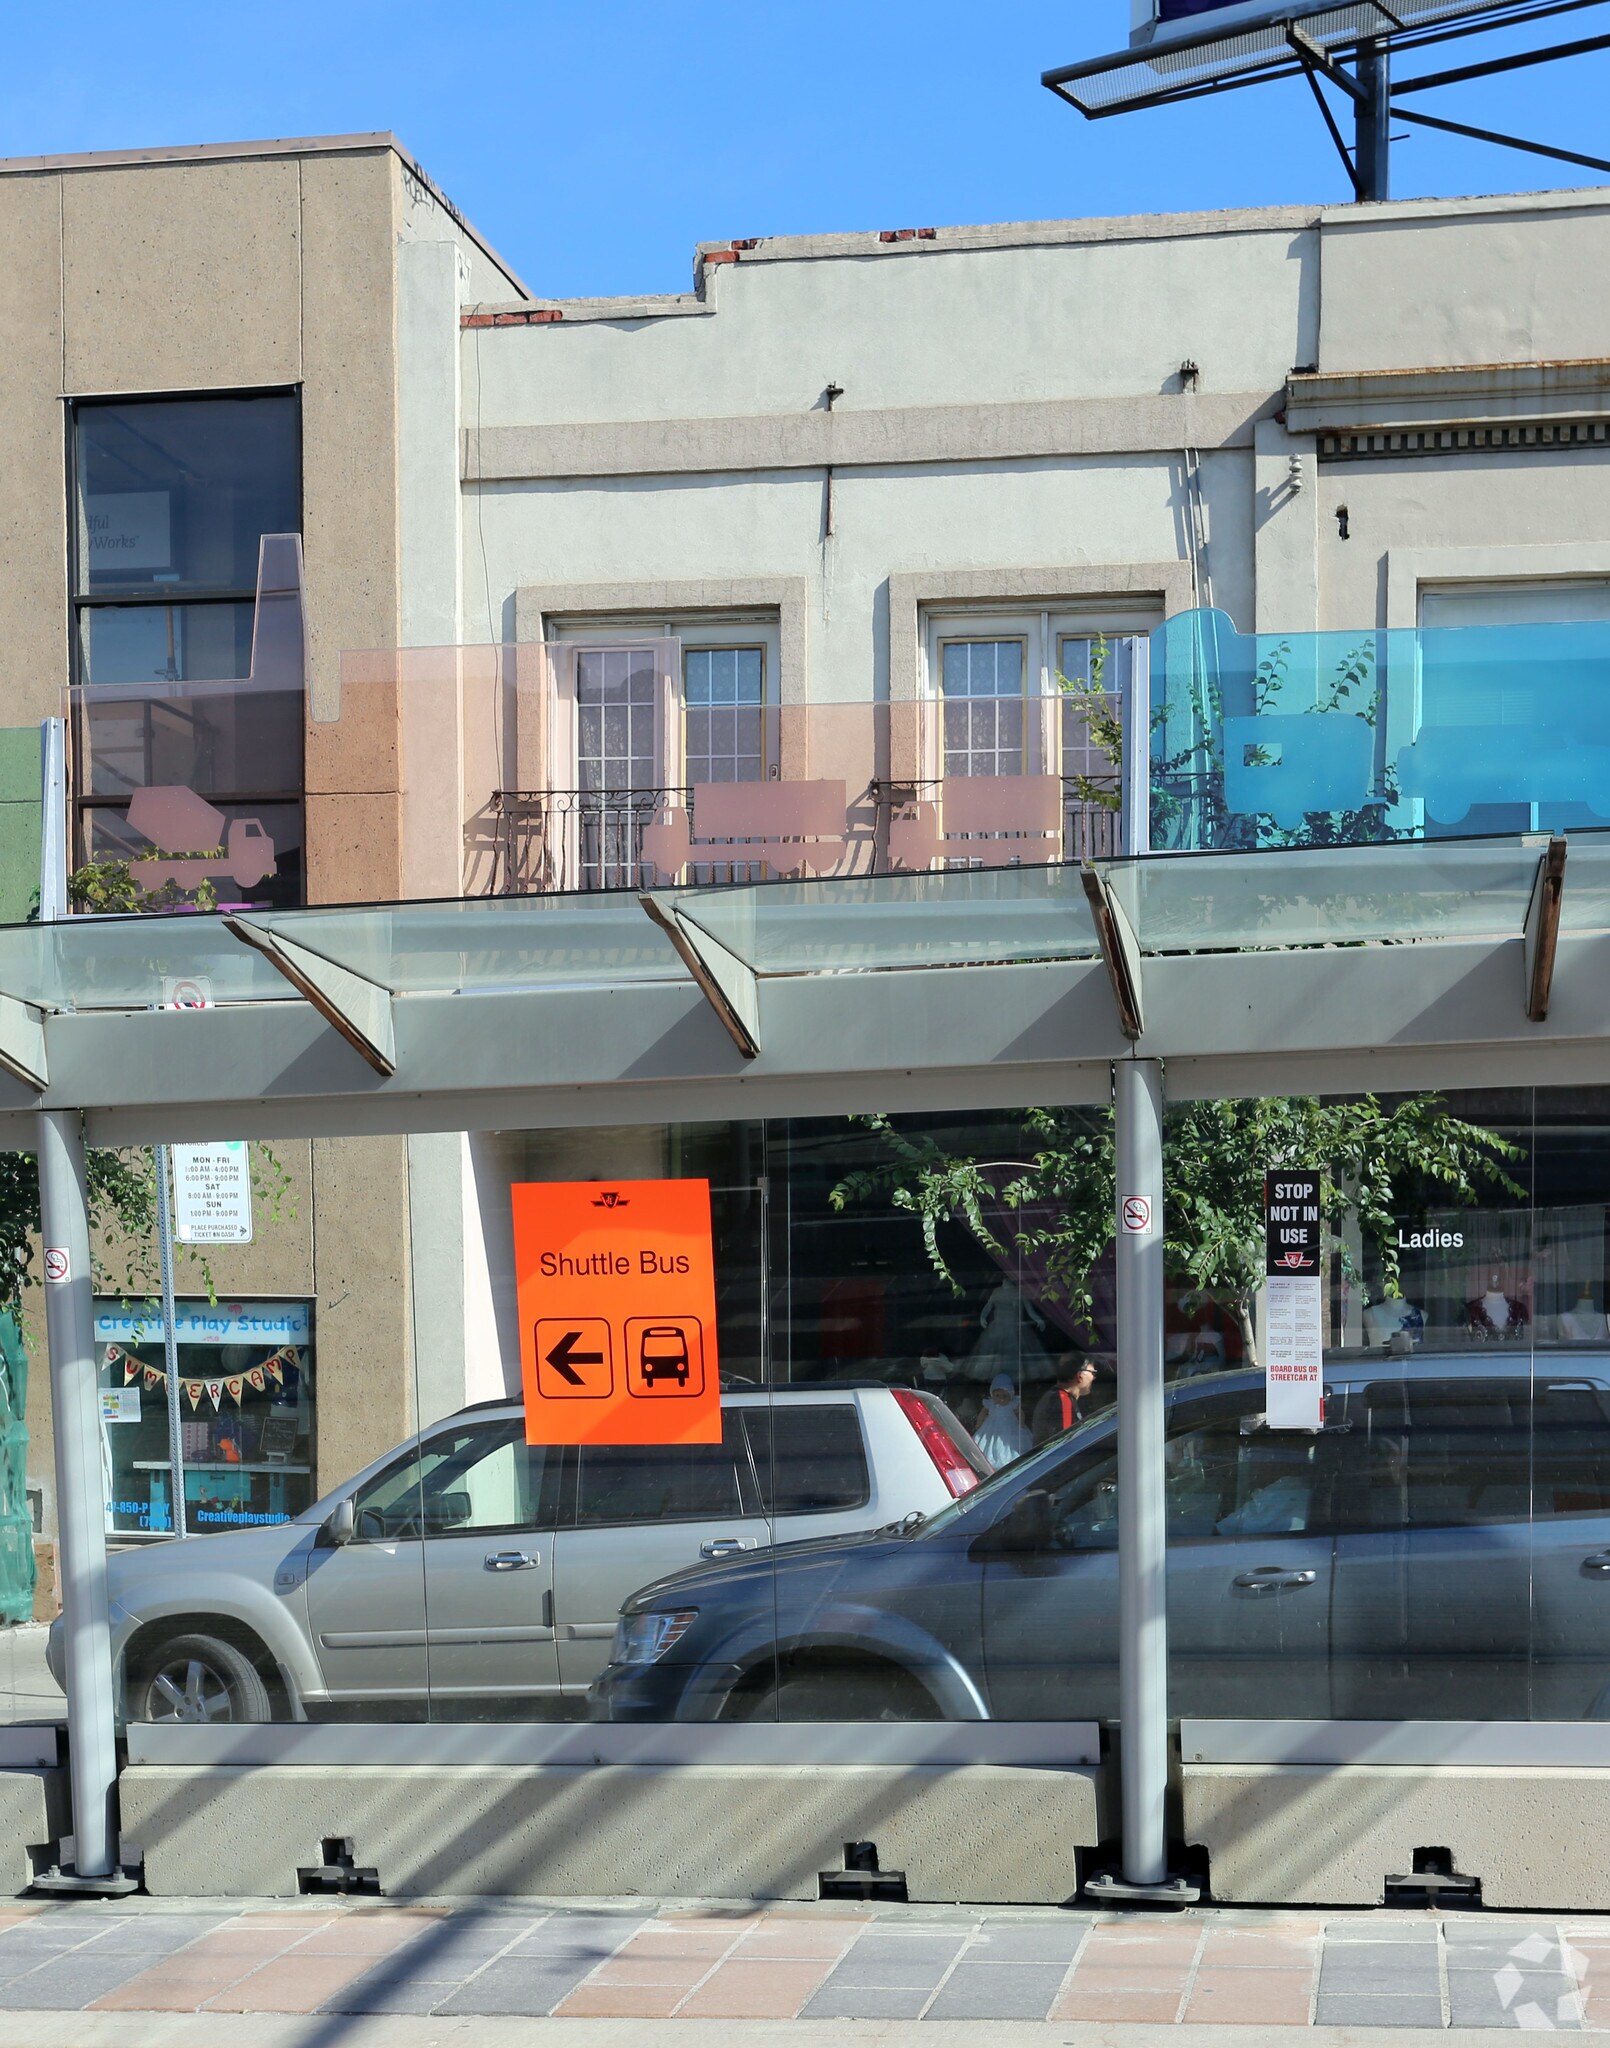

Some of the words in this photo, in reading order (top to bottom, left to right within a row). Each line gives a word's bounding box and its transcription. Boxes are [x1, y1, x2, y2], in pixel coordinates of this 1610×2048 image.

[1275, 1183, 1313, 1199] STOP
[1270, 1206, 1299, 1221] NOT
[1303, 1206, 1318, 1221] IN
[1280, 1228, 1308, 1244] USE
[1398, 1228, 1464, 1248] Ladies
[540, 1251, 630, 1277] Shuttle
[639, 1250, 690, 1275] Bus
[98, 1314, 183, 1330] Creatie
[190, 1315, 232, 1334] Play
[237, 1315, 302, 1331] Studio
[1270, 1365, 1293, 1373] BOARD
[1293, 1365, 1307, 1373] BUS
[1308, 1365, 1318, 1373] OR
[1270, 1373, 1308, 1382] STREETCAR
[1309, 1373, 1318, 1382] AT
